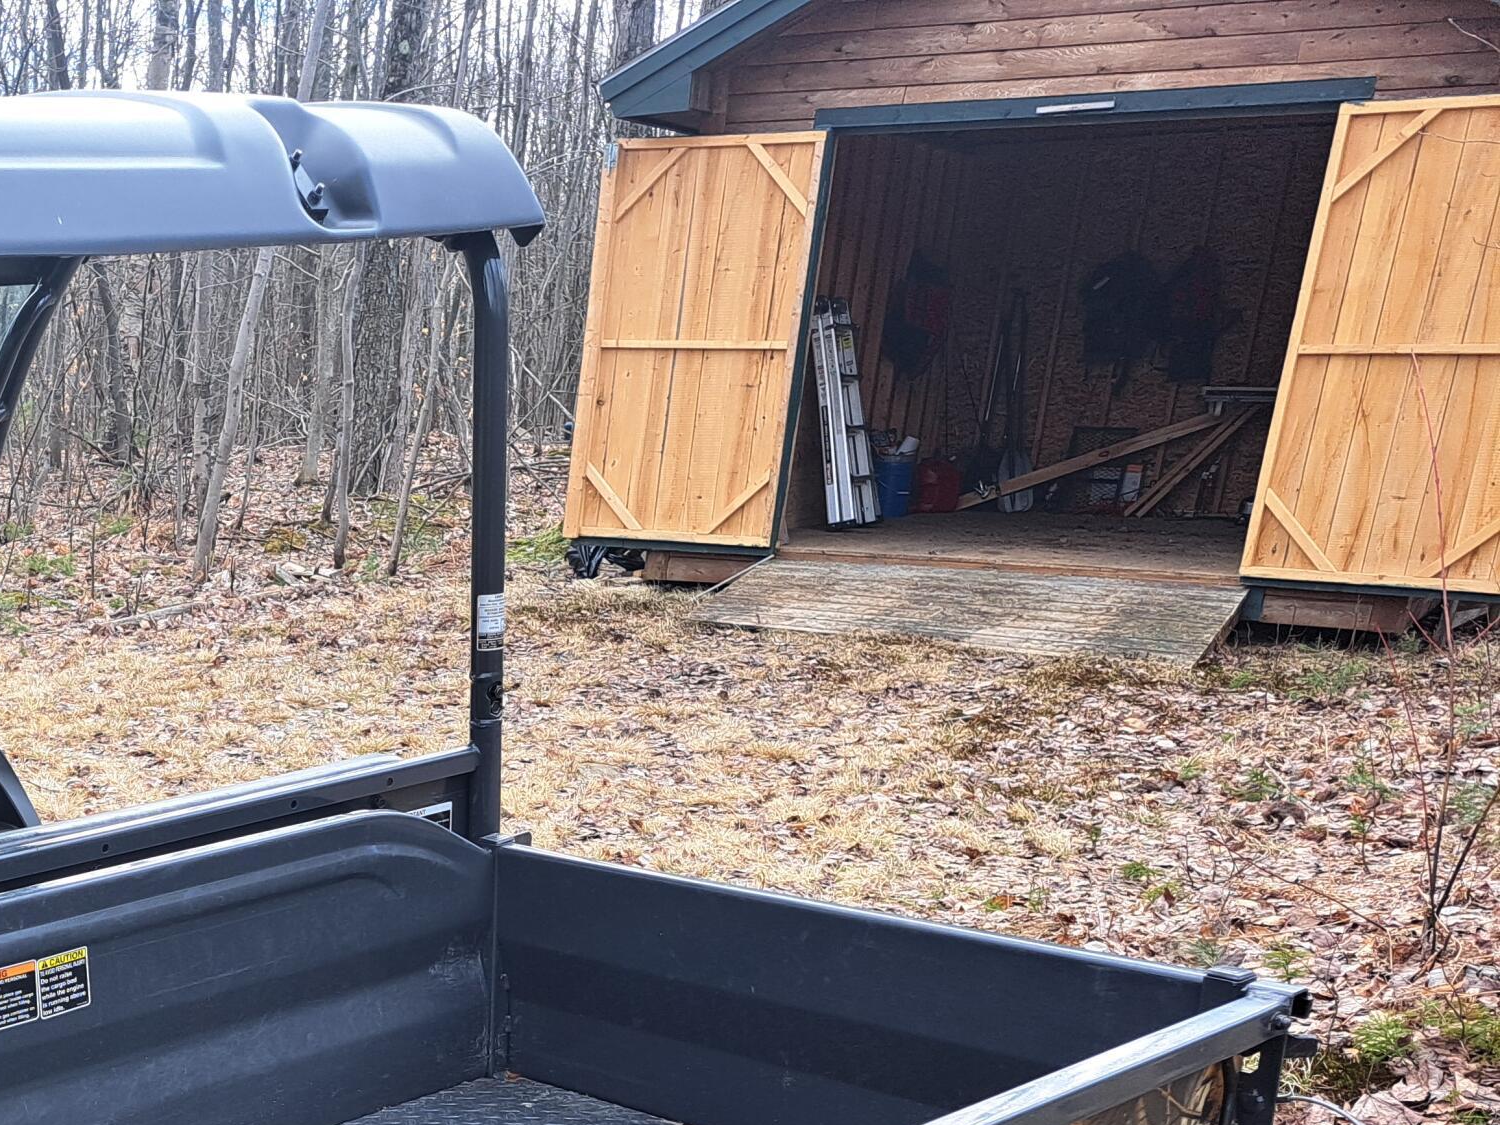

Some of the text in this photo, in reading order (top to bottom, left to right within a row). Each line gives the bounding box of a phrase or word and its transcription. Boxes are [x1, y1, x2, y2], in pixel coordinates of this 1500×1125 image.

[49, 949, 82, 966] CAUTION
[40, 977, 48, 985] Do
[50, 980, 65, 991] cargo
[66, 982, 84, 994] engine
[48, 995, 69, 1007] running
